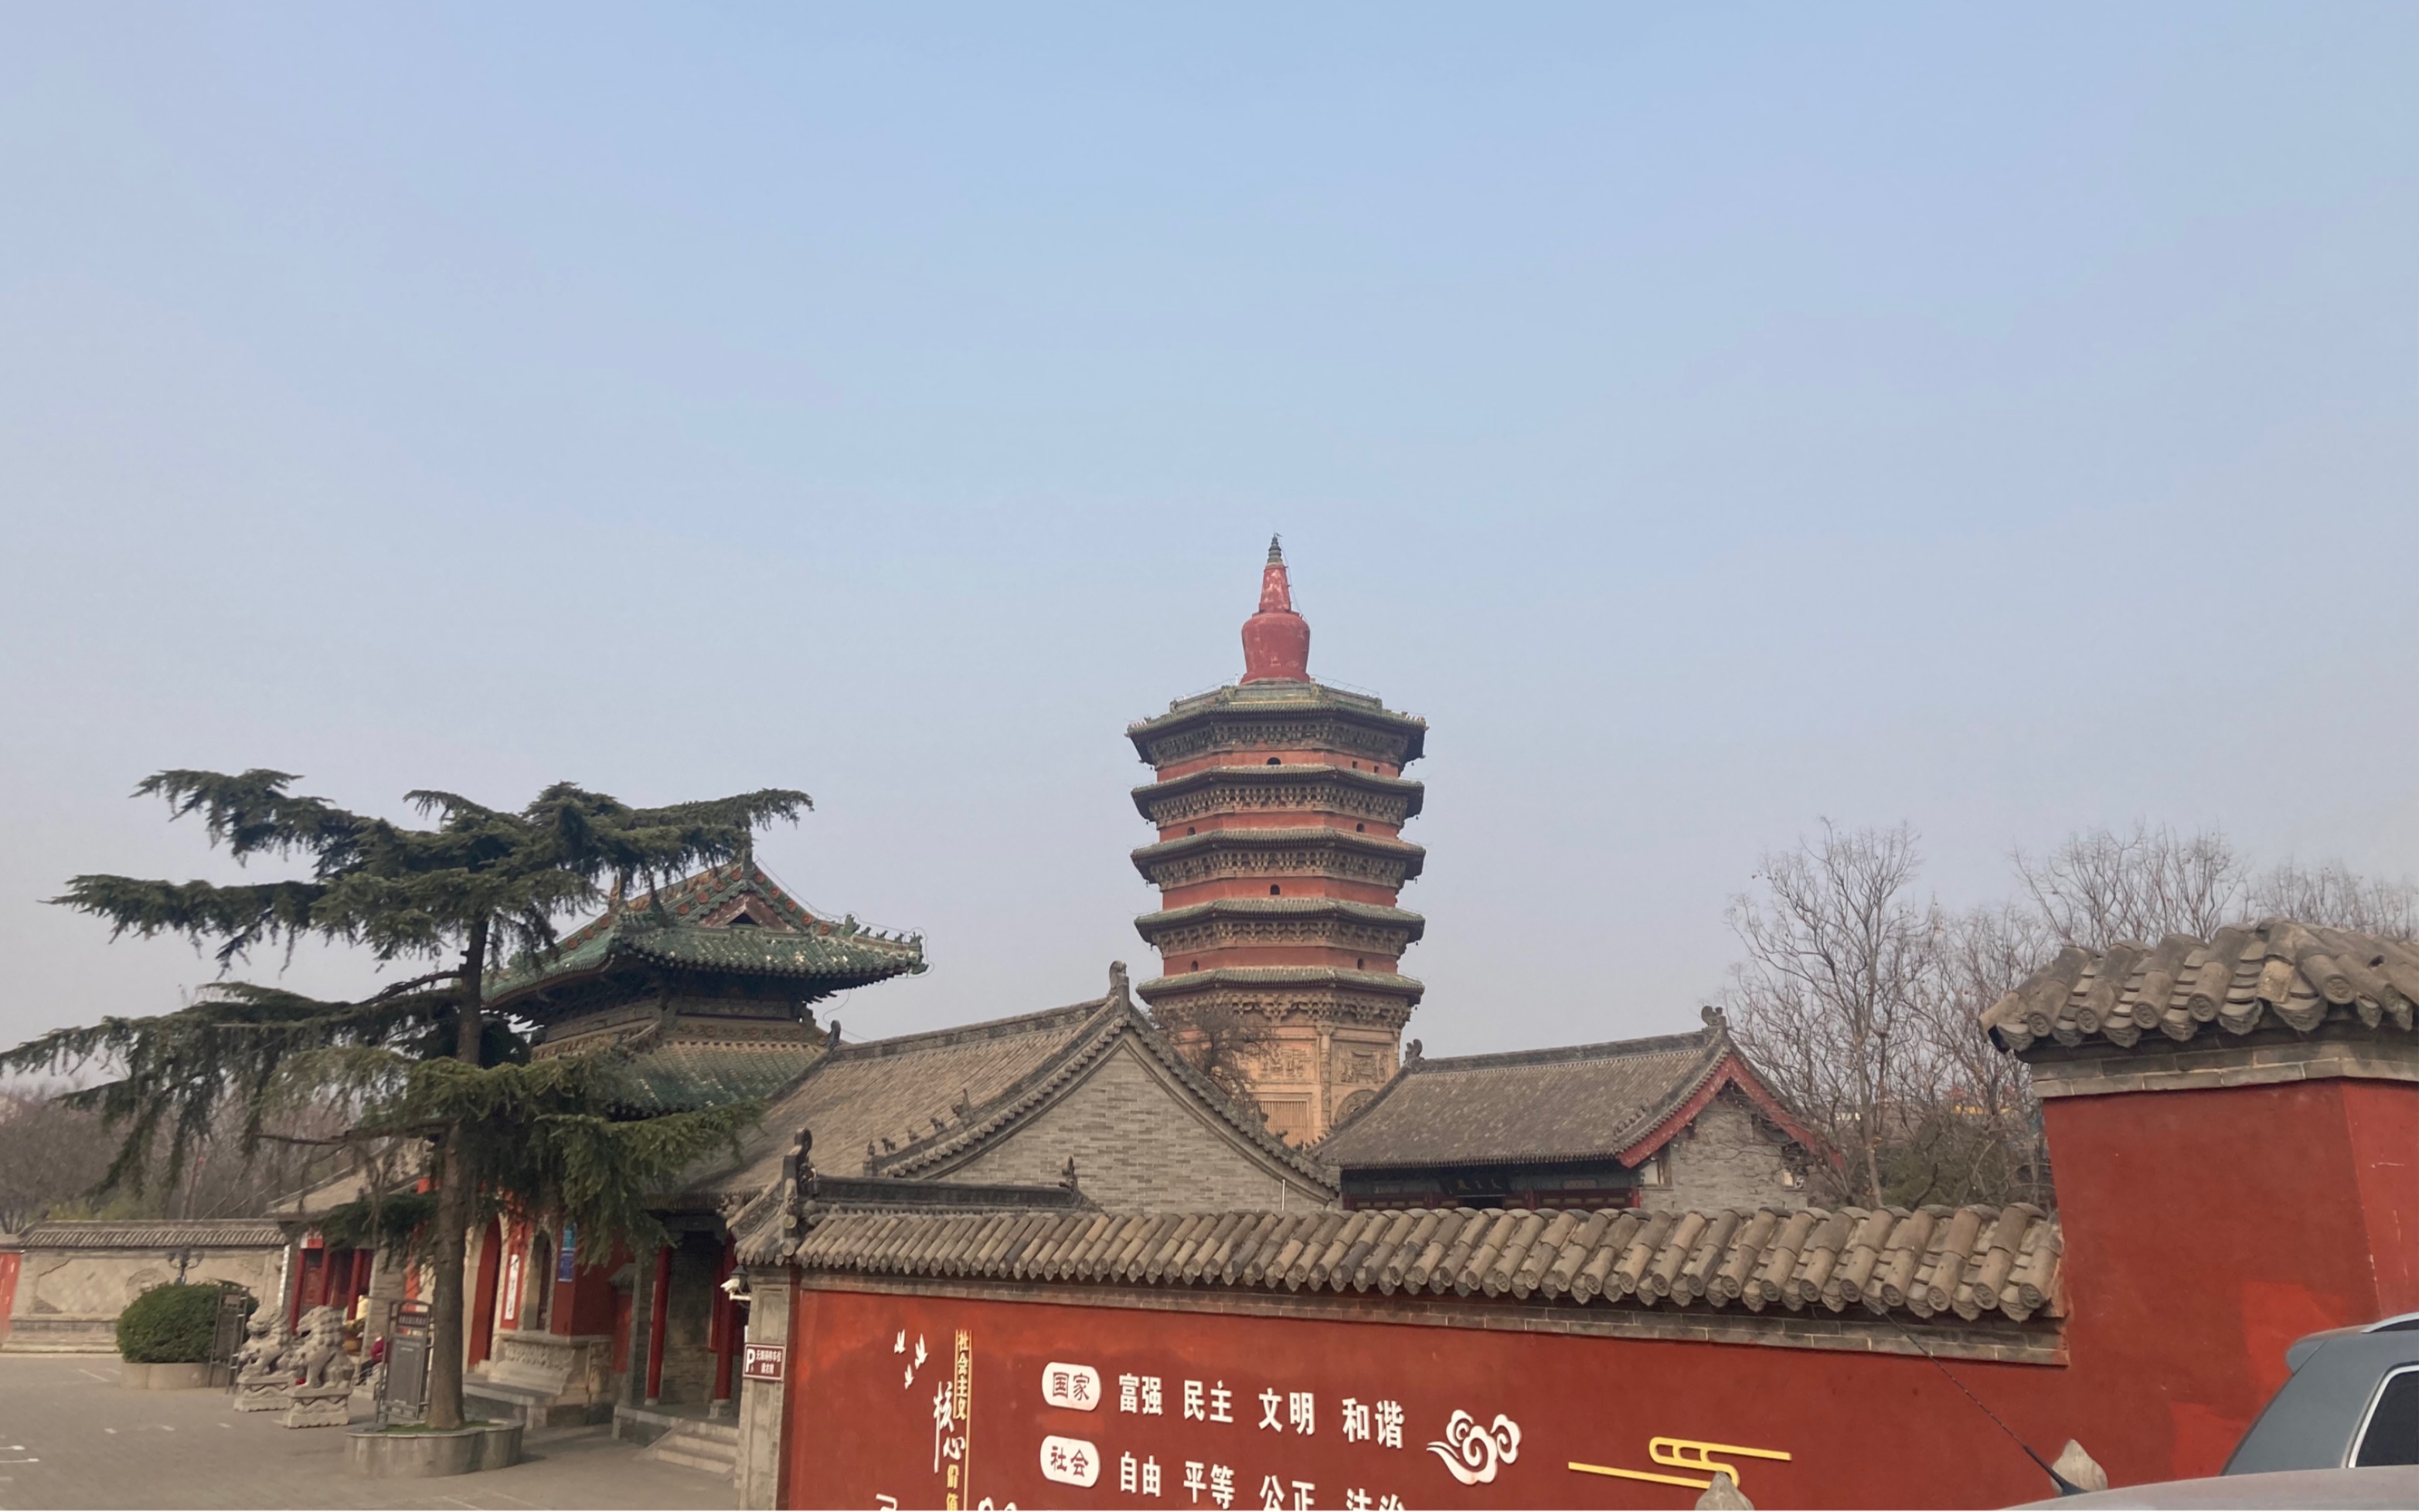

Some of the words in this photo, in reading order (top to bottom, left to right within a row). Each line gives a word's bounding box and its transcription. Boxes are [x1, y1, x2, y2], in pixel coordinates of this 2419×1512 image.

[746, 1348, 756, 1373] P
[955, 1330, 969, 1420] 社会主义
[1053, 1371, 1090, 1402] 国家
[1119, 1373, 1163, 1415] 富强
[1184, 1380, 1233, 1423] 民主
[1258, 1388, 1315, 1436] 文明
[1342, 1397, 1405, 1449] 和谐
[1050, 1446, 1089, 1477] 社会
[1121, 1451, 1161, 1497] 自由
[1183, 1460, 1235, 1510] 平等
[1259, 1475, 1315, 1510] 公正
